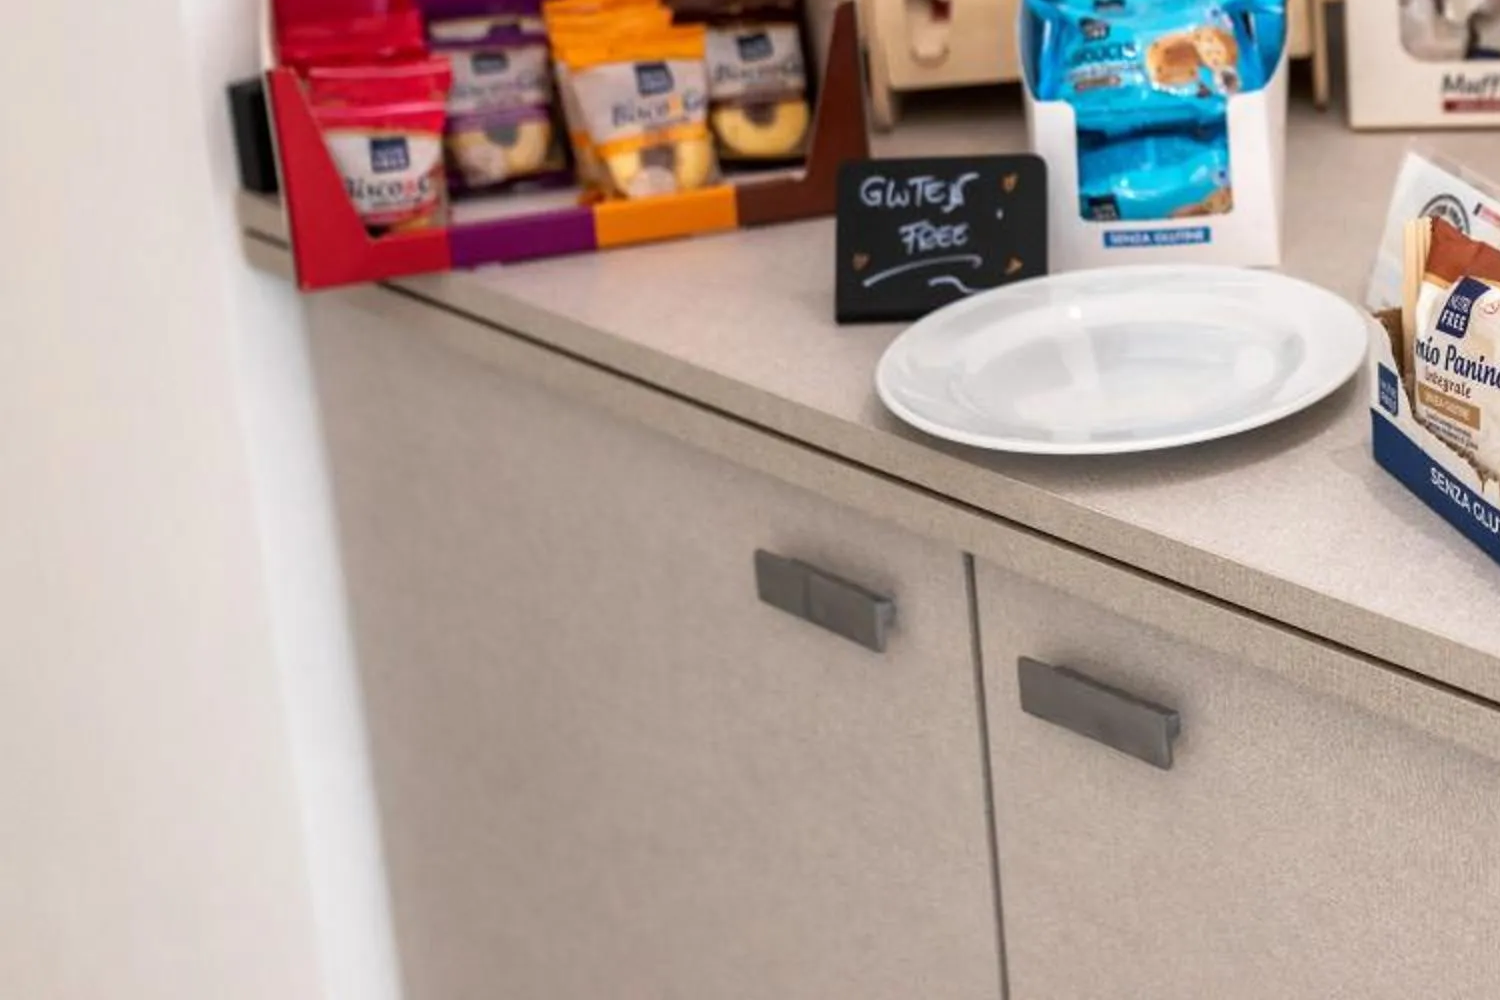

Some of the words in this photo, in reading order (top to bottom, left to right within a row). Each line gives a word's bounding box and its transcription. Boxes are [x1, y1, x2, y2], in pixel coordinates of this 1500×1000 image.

[1440, 311, 1468, 332] FREE
[1424, 369, 1472, 399] Integrale
[1429, 466, 1471, 513] SENZA
